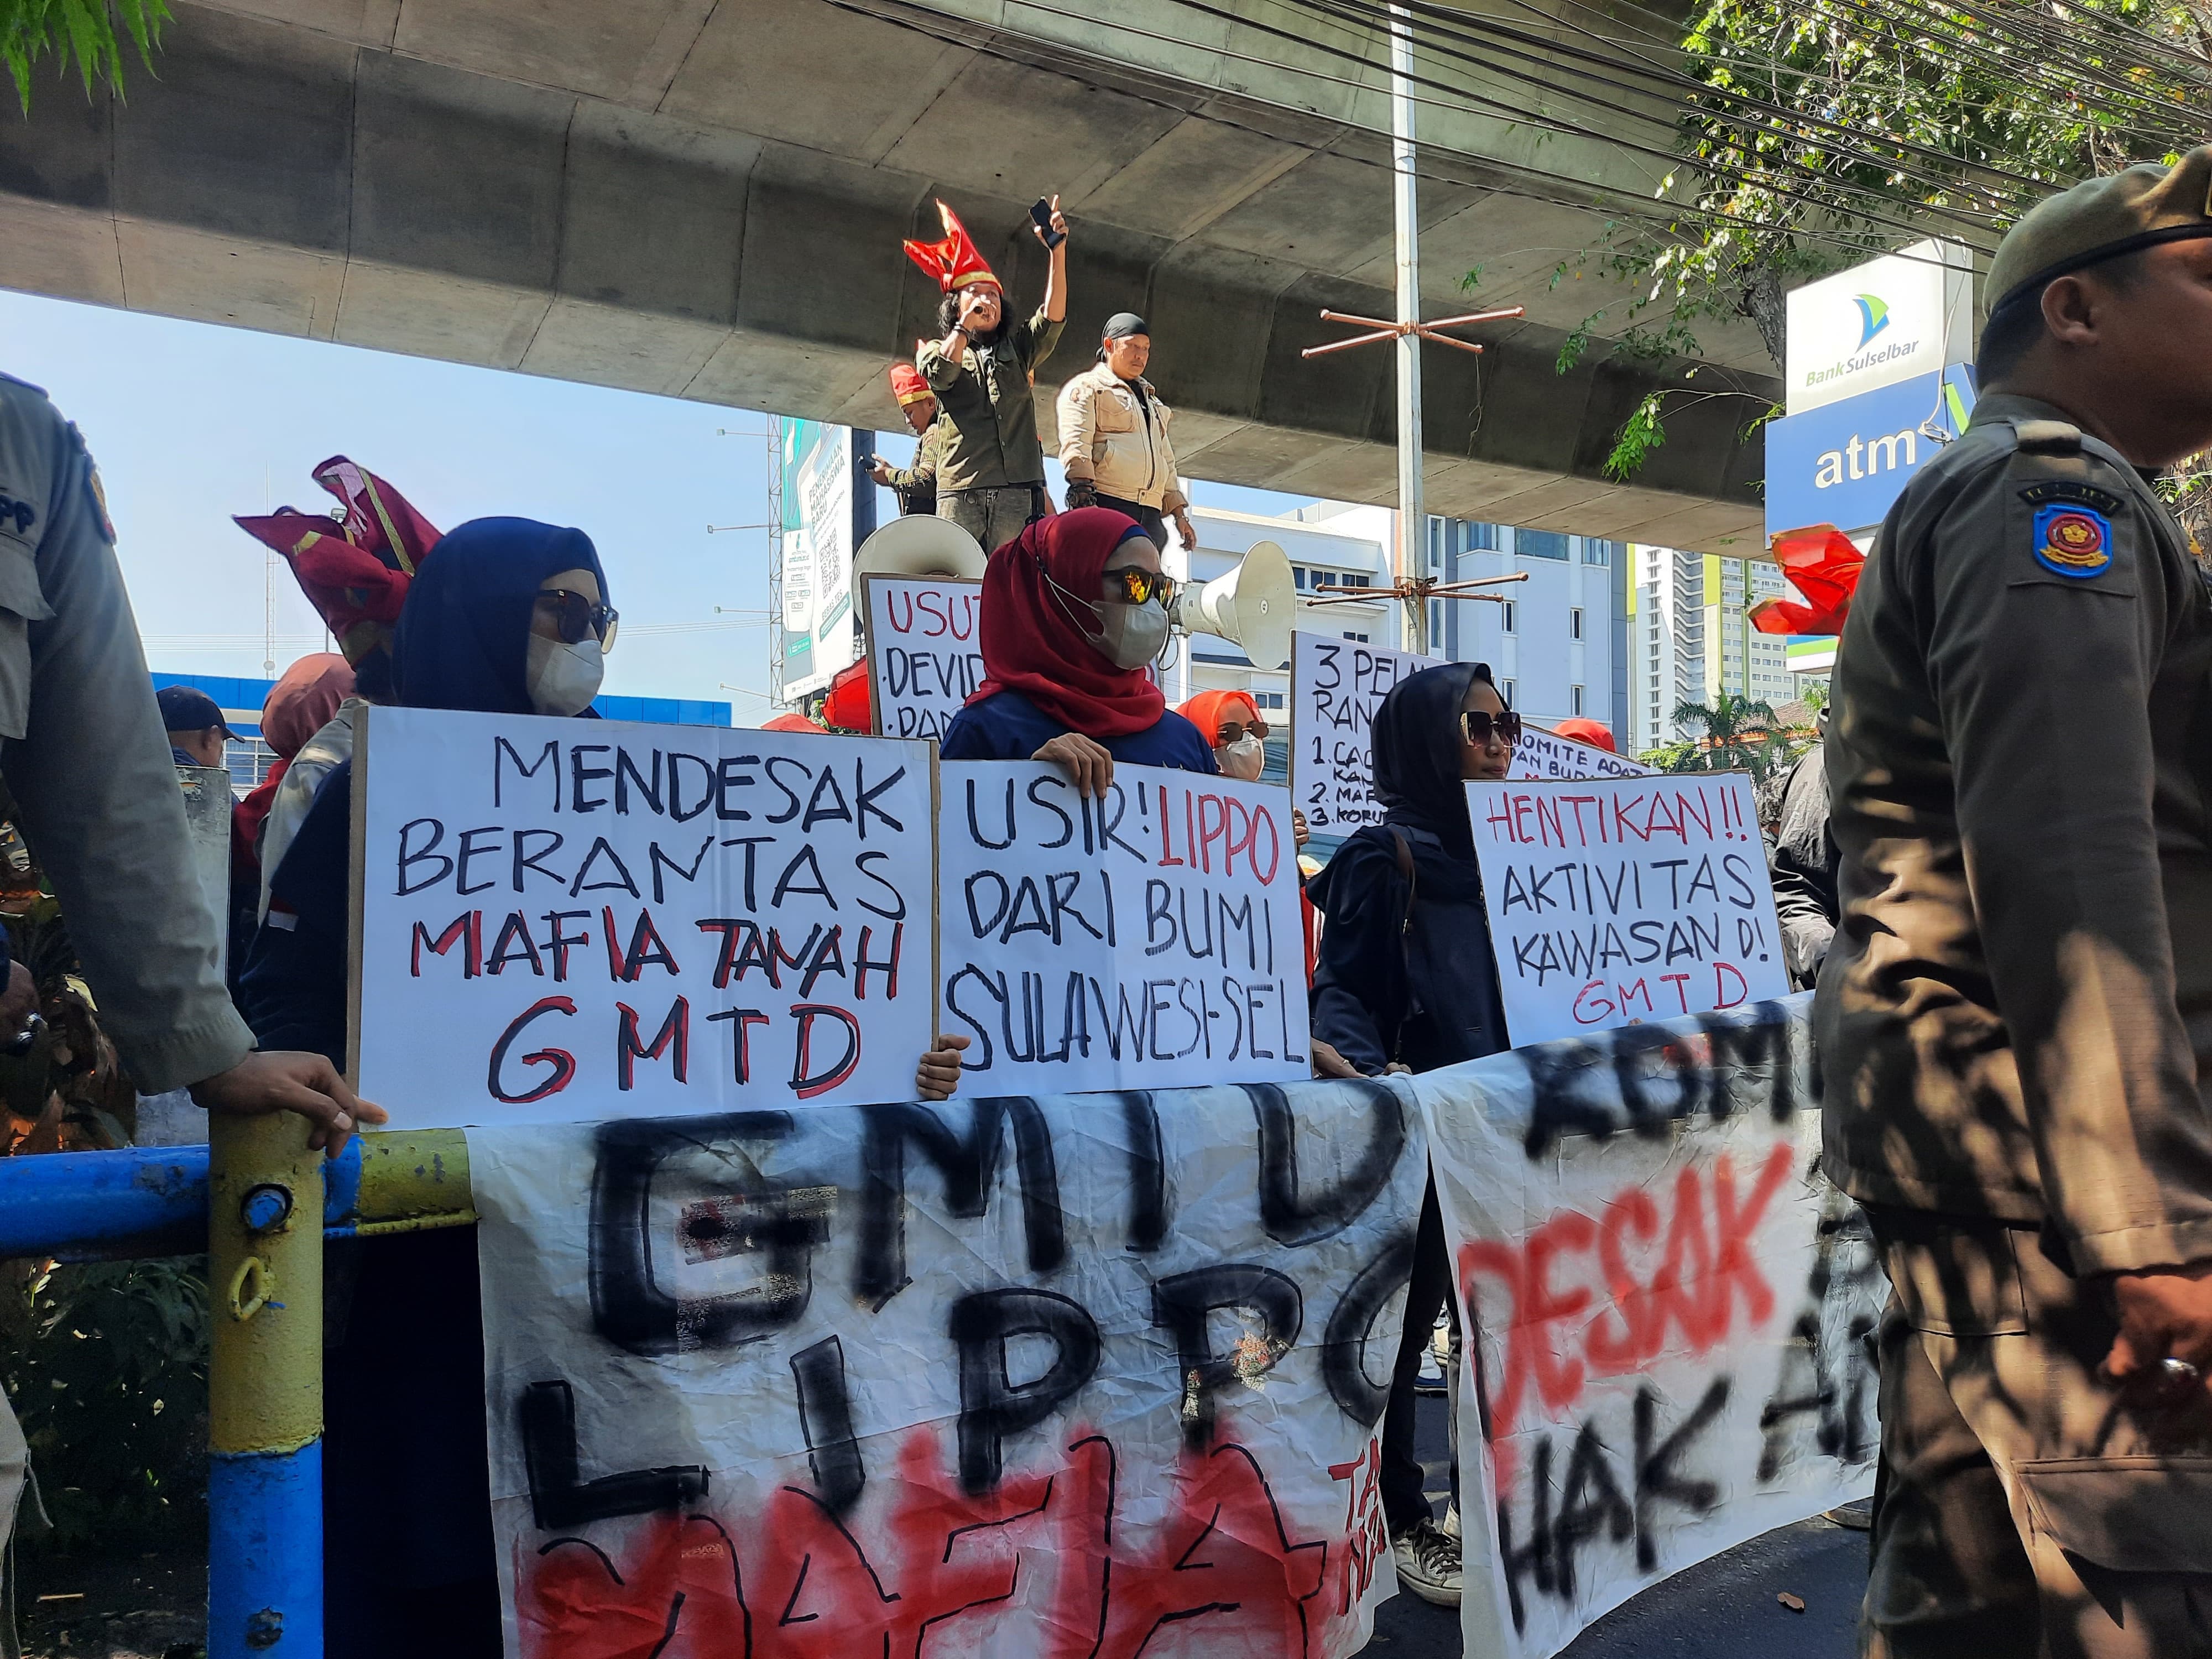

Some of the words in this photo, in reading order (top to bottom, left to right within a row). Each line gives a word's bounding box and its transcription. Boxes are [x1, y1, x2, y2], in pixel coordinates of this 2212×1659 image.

[809, 440, 843, 503] PENERIMAAN
[811, 455, 845, 517] MAHASISWA
[1814, 428, 1916, 489] atm
[811, 498, 827, 530] BARU
[1314, 644, 1341, 690] 3
[1513, 734, 1588, 766] OMITE
[1549, 761, 1594, 779] BUD
[494, 735, 906, 841] MENDESAK
[1486, 785, 1747, 849] HENTIKAN!!
[1157, 784, 1279, 886] LIPPO
[392, 818, 907, 921] BERANTAS
[1503, 853, 1756, 915] AKTIVITAS
[411, 905, 680, 984] MAFIA
[695, 918, 904, 1000] TANAH
[964, 869, 1116, 947] DARI
[1145, 878, 1272, 976] BUMI
[1512, 912, 1720, 987] KAWASAN
[1572, 962, 1749, 1024] GMTD
[487, 994, 861, 1104] GMTD
